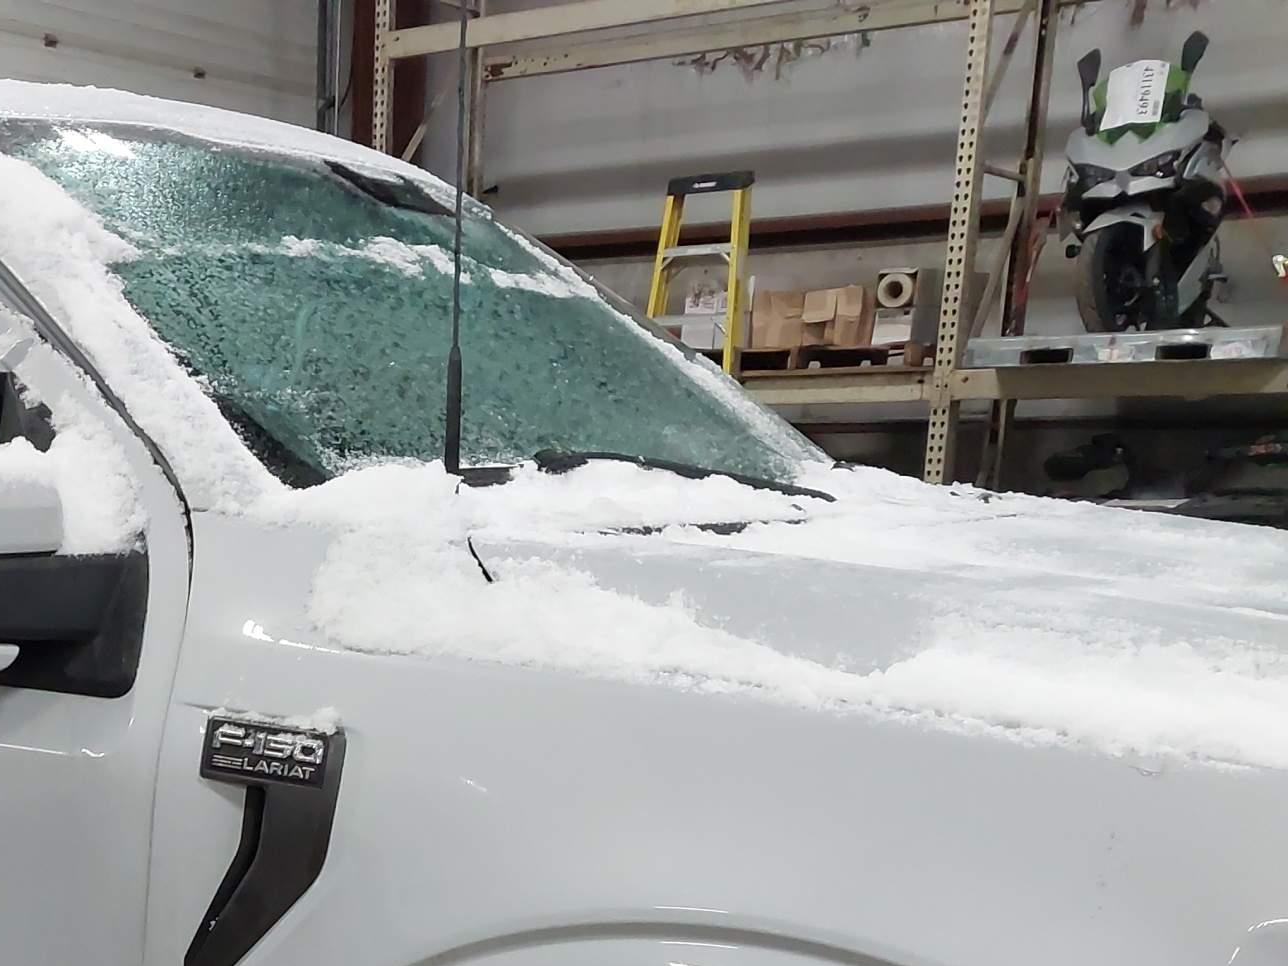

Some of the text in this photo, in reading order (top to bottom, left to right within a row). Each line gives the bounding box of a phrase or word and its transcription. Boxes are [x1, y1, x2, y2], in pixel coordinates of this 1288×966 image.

[1136, 65, 1154, 115] 43119493
[212, 723, 324, 764] F-150
[242, 757, 316, 780] LARIAT
